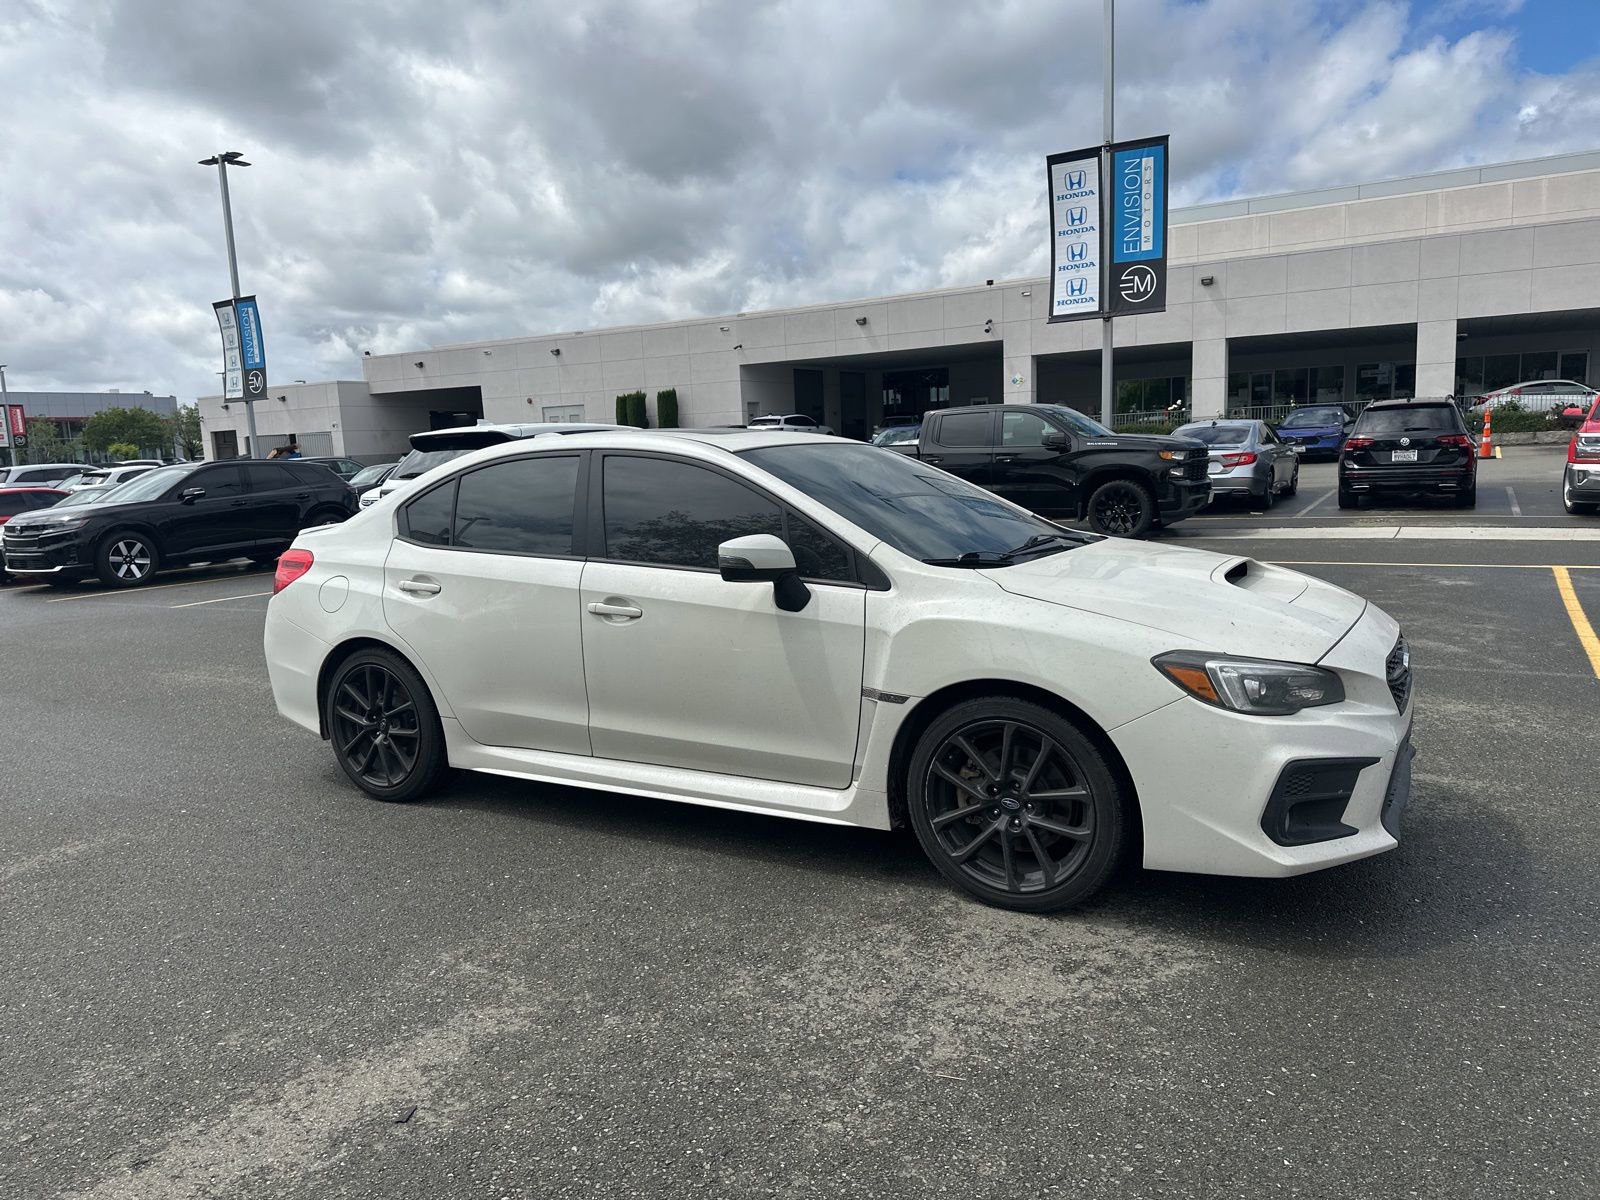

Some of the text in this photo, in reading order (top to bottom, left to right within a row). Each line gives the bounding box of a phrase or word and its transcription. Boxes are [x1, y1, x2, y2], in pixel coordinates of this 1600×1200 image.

[1056, 189, 1096, 201] HONDA
[1123, 158, 1140, 253] ENVISION
[1144, 165, 1152, 243] MOTORS
[1058, 226, 1096, 237] HONDA
[1058, 262, 1096, 272] HONDA
[1056, 296, 1096, 306] HONDA
[242, 307, 254, 364] ENVISION
